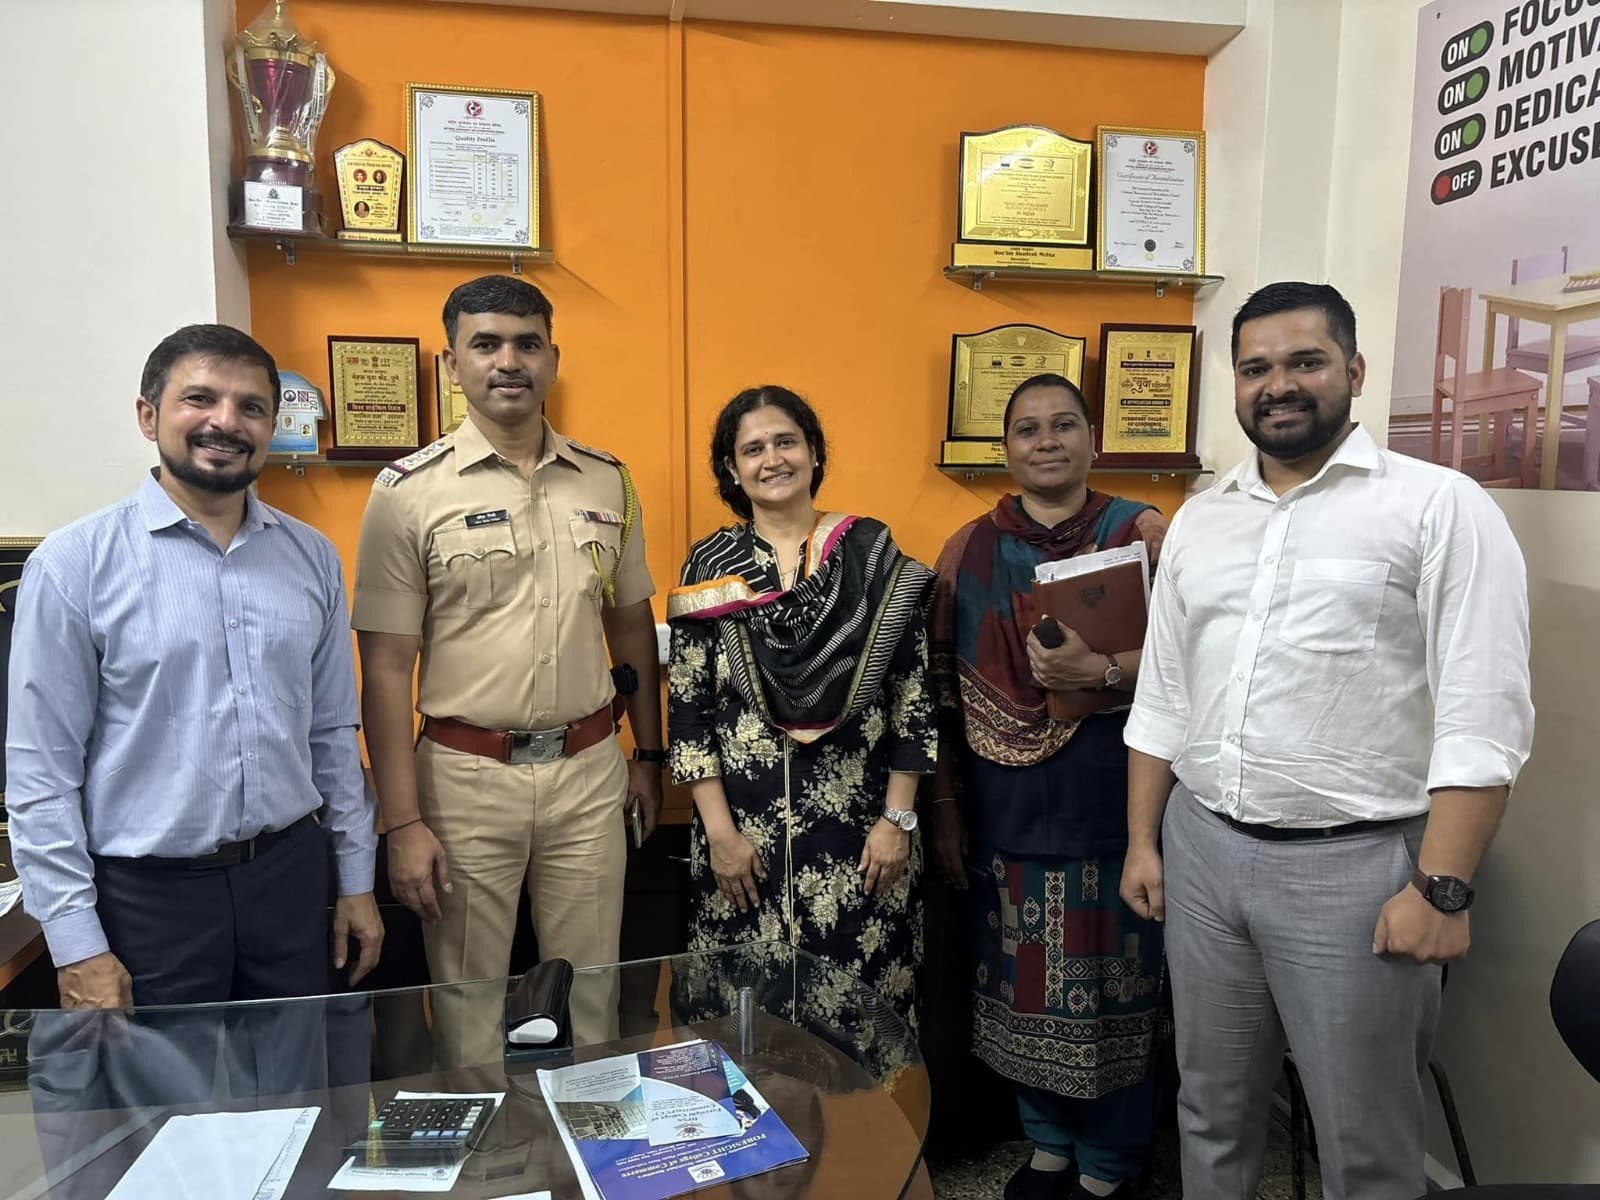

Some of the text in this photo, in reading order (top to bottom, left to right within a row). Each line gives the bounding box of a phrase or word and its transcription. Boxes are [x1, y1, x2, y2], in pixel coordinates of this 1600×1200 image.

[1502, 0, 1600, 46] FOC
[1447, 36, 1470, 65] ON
[1498, 16, 1600, 91] MOTIV
[1443, 80, 1466, 109] ON
[1440, 128, 1462, 154] ON
[1451, 169, 1476, 191] OFF
[680, 1149, 711, 1162] College
[712, 1133, 767, 1155] FORESIGHT
[621, 1163, 668, 1178] Commerce
[669, 1160, 678, 1168] of
